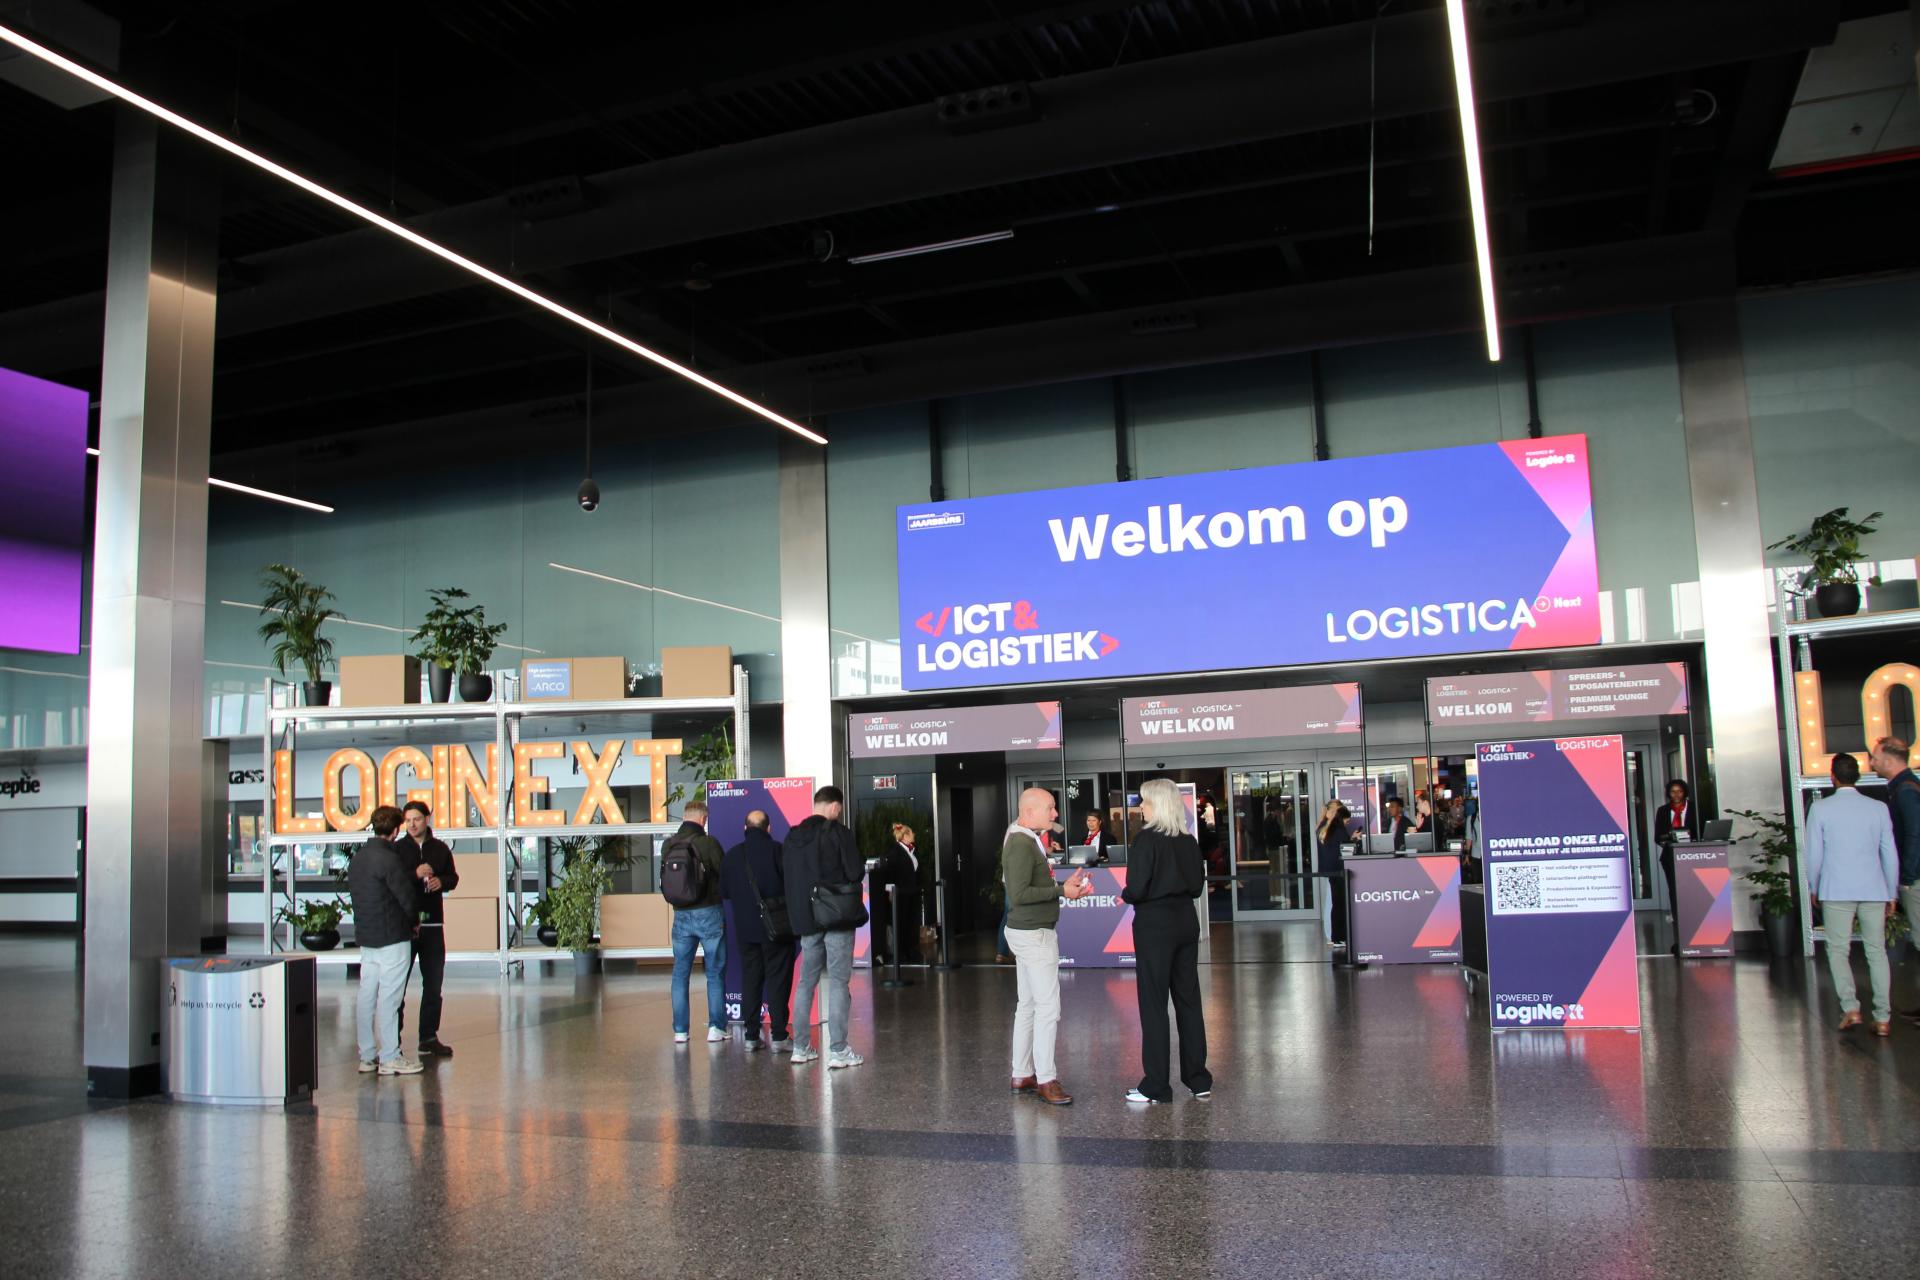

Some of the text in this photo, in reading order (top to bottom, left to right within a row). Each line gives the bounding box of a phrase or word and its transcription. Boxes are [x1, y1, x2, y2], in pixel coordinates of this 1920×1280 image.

[910, 515, 962, 528] JAARBEURS
[1048, 495, 1408, 562] Welkom op
[1326, 595, 1582, 644] LOGISTICA Next
[1568, 671, 1626, 681] SPREKERS- &
[1569, 679, 1661, 691] EXPOSANTENENTREE
[1478, 687, 1511, 696] LOGISTICA
[1570, 692, 1649, 704] PREMIUM LOUNGE
[1192, 704, 1233, 714] LOGISTICA
[1438, 702, 1513, 717] WELKOM
[1571, 704, 1616, 713] HELPDESK
[910, 720, 947, 730] LOGISTICA
[1141, 716, 1235, 735] WELKOM
[865, 731, 949, 749] WELKOM
[1555, 738, 1610, 752] LOGISTICA
[0, 775, 41, 799] eptie
[763, 779, 804, 789] LOGISTICA
[1489, 833, 1626, 849] DOWNLOAD ONZE APP
[1503, 849, 1522, 857] HAAL
[1523, 848, 1546, 856] ALLES
[1546, 847, 1560, 855] UIT
[1571, 845, 1625, 854] BEURSBEZOEK
[1676, 853, 1717, 861] LOGISTICA
[1354, 889, 1421, 903] LOGISTICA
[1495, 993, 1553, 1002] POWERED BY
[180, 1000, 195, 1009] Help
[215, 1002, 242, 1010] recycle
[1496, 1002, 1584, 1025] LogiNext
